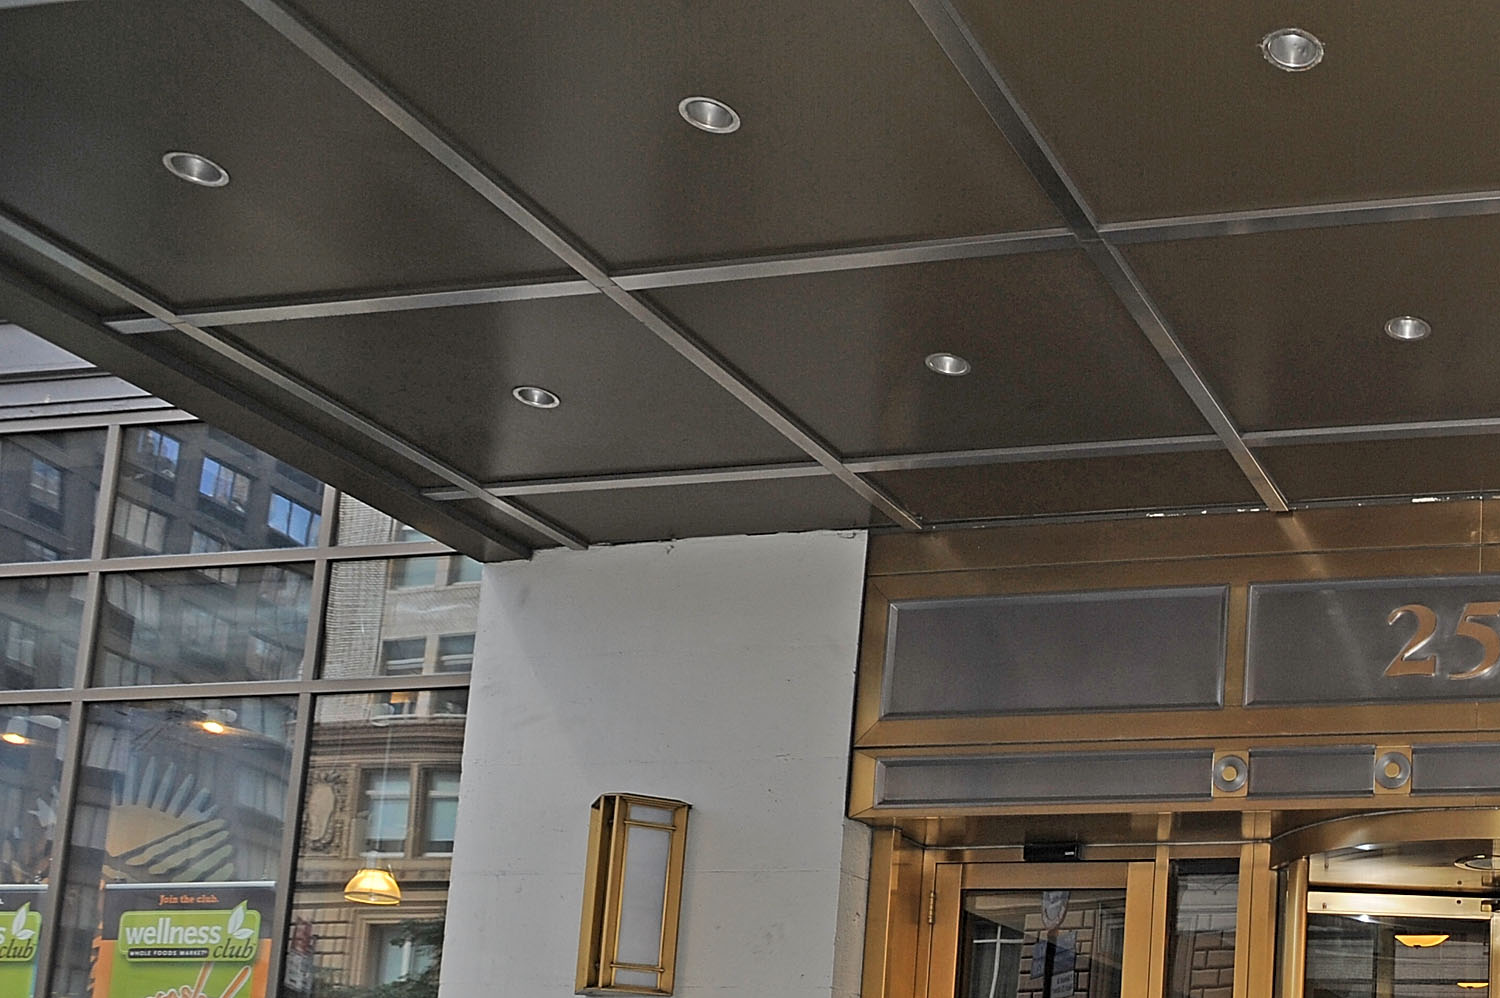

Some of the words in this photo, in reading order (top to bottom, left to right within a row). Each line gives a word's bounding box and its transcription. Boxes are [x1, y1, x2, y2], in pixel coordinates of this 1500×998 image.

[159, 895, 178, 905] Join
[180, 895, 194, 904] the
[125, 917, 222, 944] wellness
[213, 938, 253, 958] club
